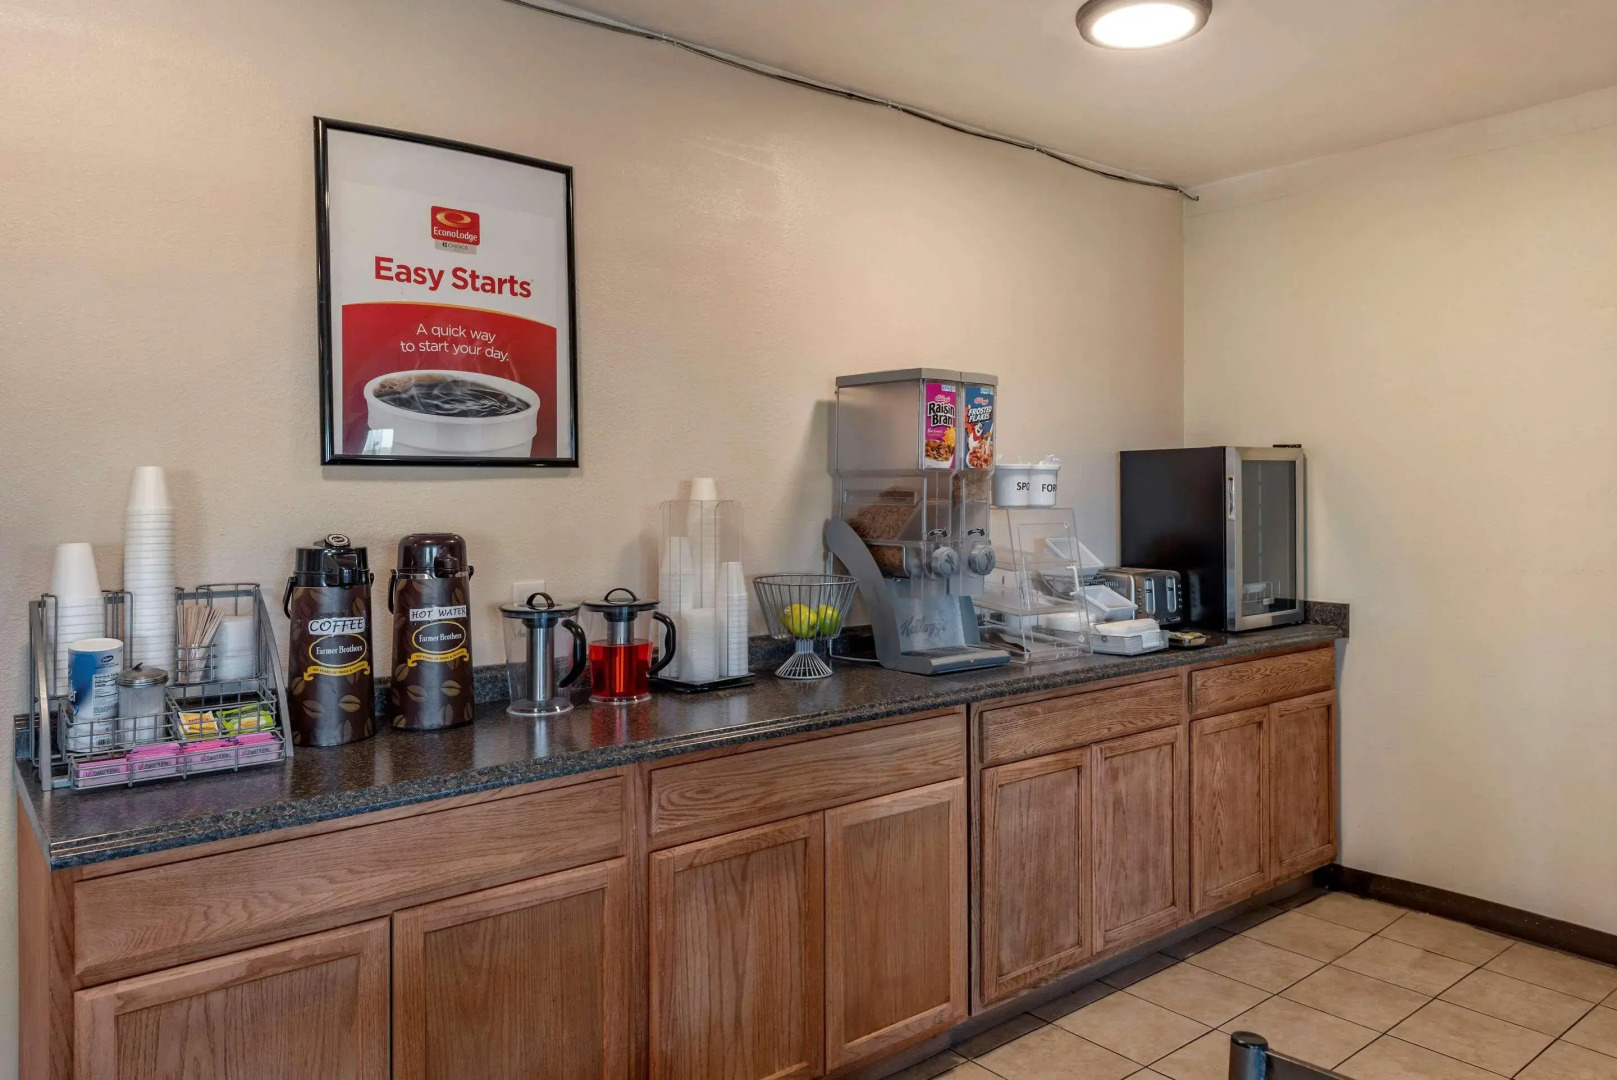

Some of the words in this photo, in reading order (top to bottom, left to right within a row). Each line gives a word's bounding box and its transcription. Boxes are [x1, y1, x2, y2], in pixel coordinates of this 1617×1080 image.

[374, 255, 445, 291] Easy
[451, 266, 532, 298] Starts
[416, 323, 428, 336] A
[431, 324, 467, 338] quick
[470, 329, 497, 344] way
[400, 340, 415, 353] to
[418, 340, 449, 353] start
[452, 343, 482, 355] your
[485, 346, 510, 362] day.
[928, 402, 956, 417] Raisin
[967, 405, 993, 417] FROSTED
[931, 413, 953, 426] Bran
[968, 412, 990, 423] FLAKES
[411, 609, 434, 619] HOT
[438, 606, 466, 617] WATER
[309, 618, 364, 633] COFFEE
[418, 634, 439, 643] Farmer
[439, 632, 462, 641] Brothers
[315, 646, 338, 655] Farmer
[338, 644, 363, 654] Brothers
